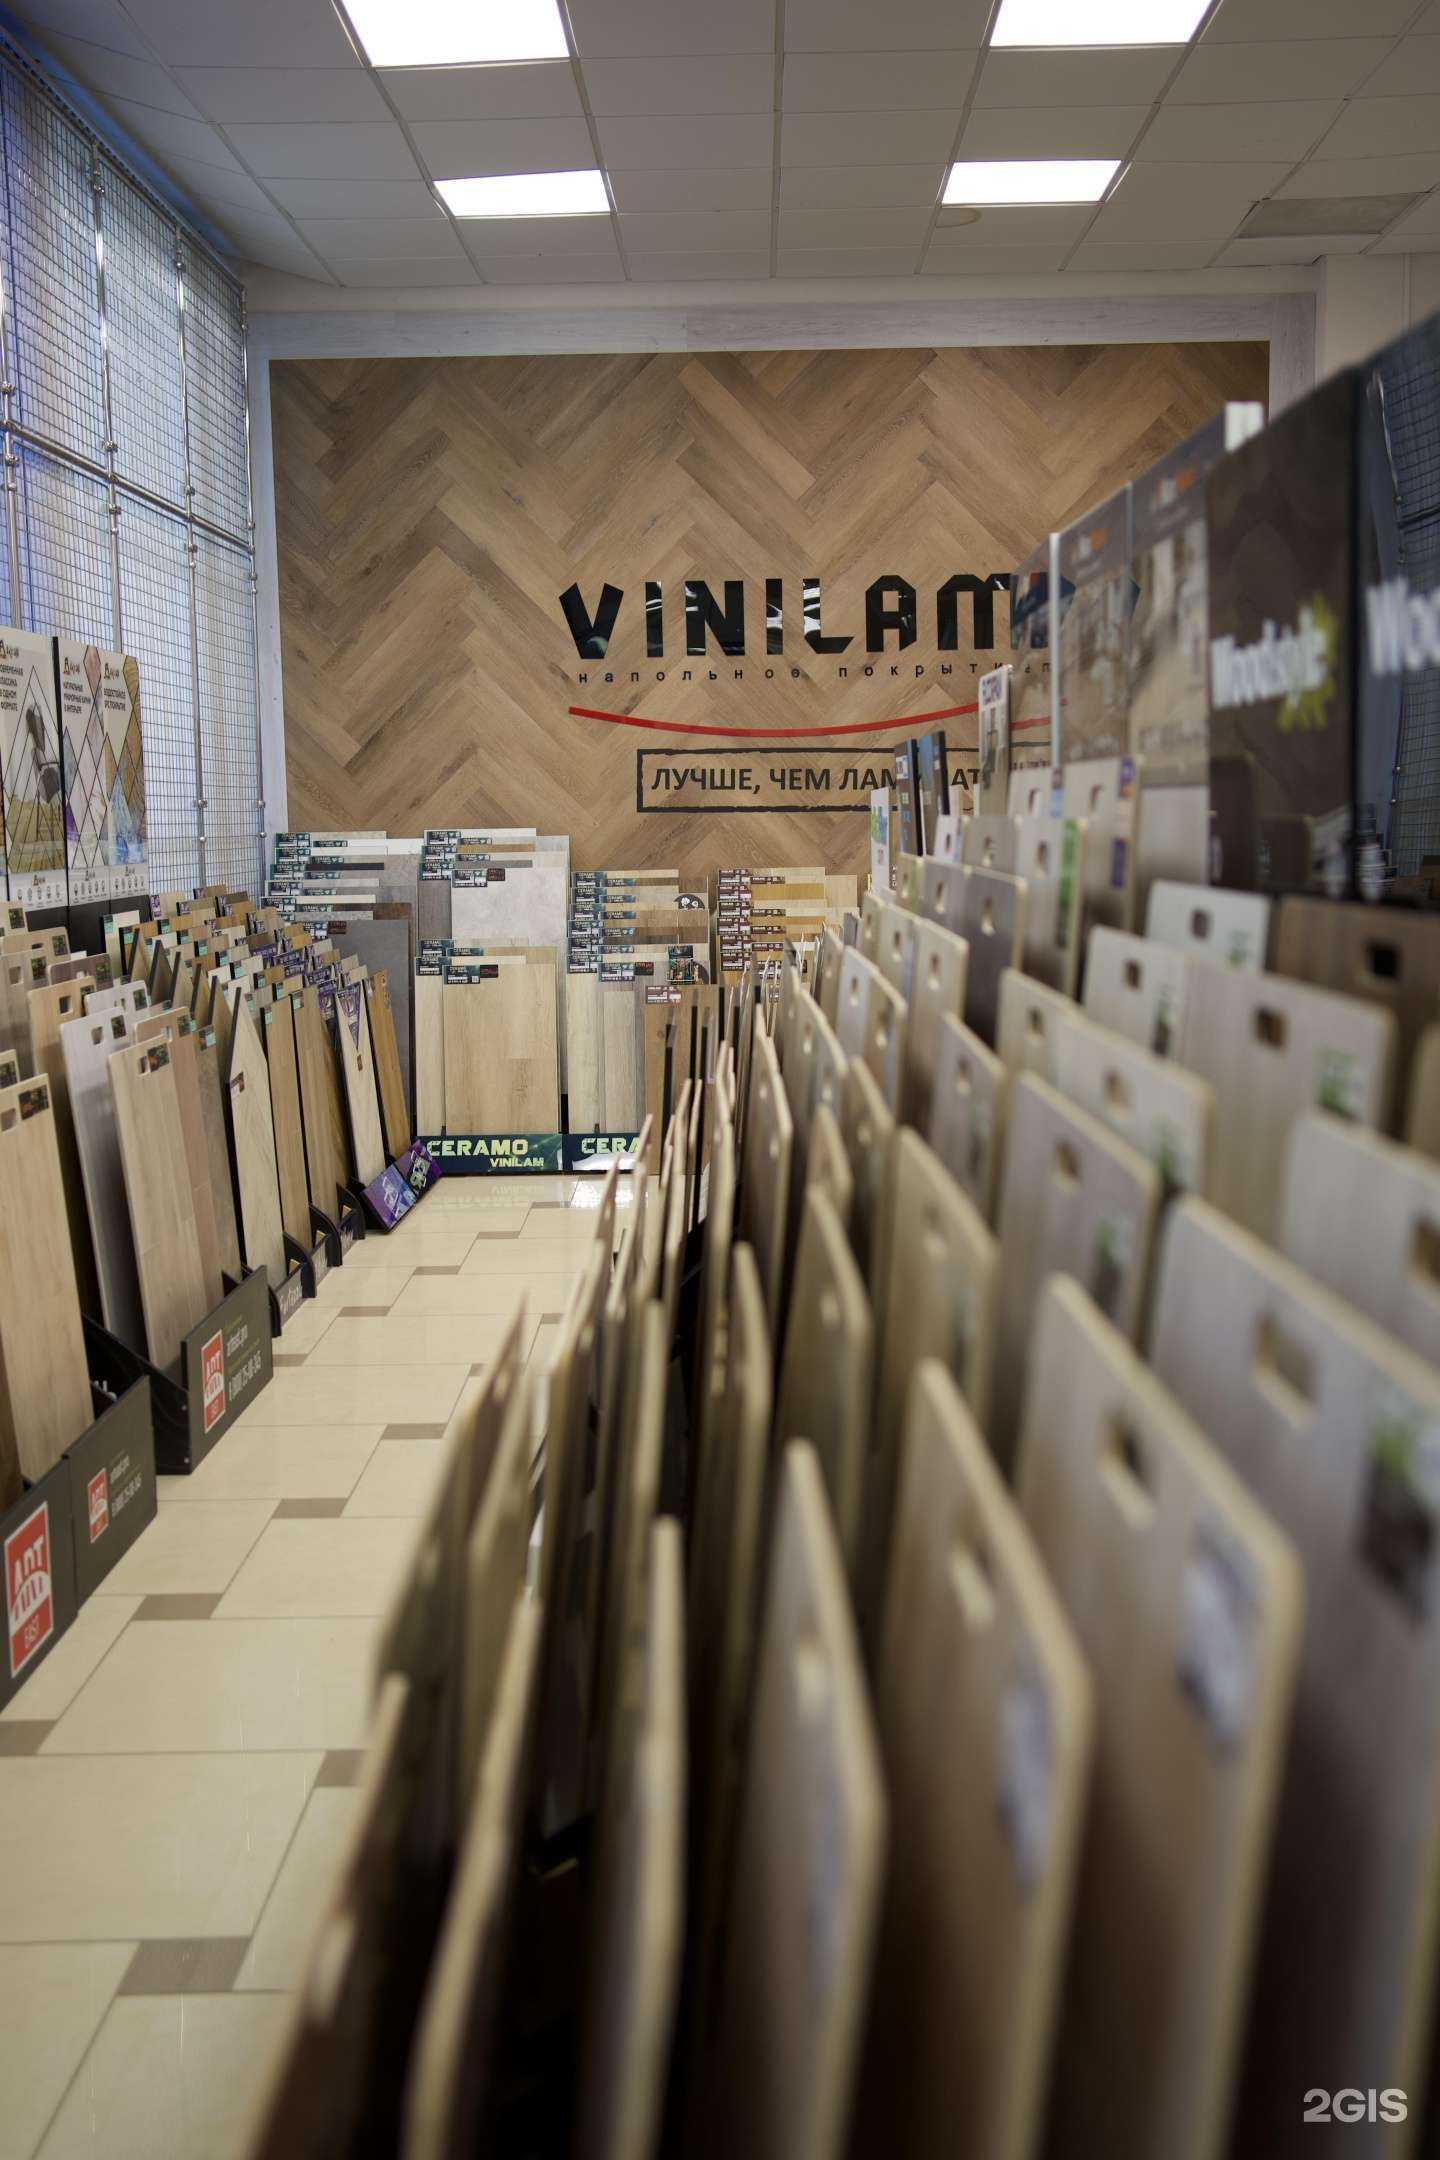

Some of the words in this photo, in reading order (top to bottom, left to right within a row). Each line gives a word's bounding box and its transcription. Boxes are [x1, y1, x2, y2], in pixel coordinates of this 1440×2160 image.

[558, 573, 1012, 661] VINILAM
[578, 667, 801, 683] напольное
[651, 768, 761, 795] ЛУЧШЕ,
[769, 768, 831, 791] ЧЕМ
[838, 768, 981, 791] ЛАМАТ
[426, 1138, 529, 1156] CERAMO
[490, 1157, 544, 1168] VINILAM
